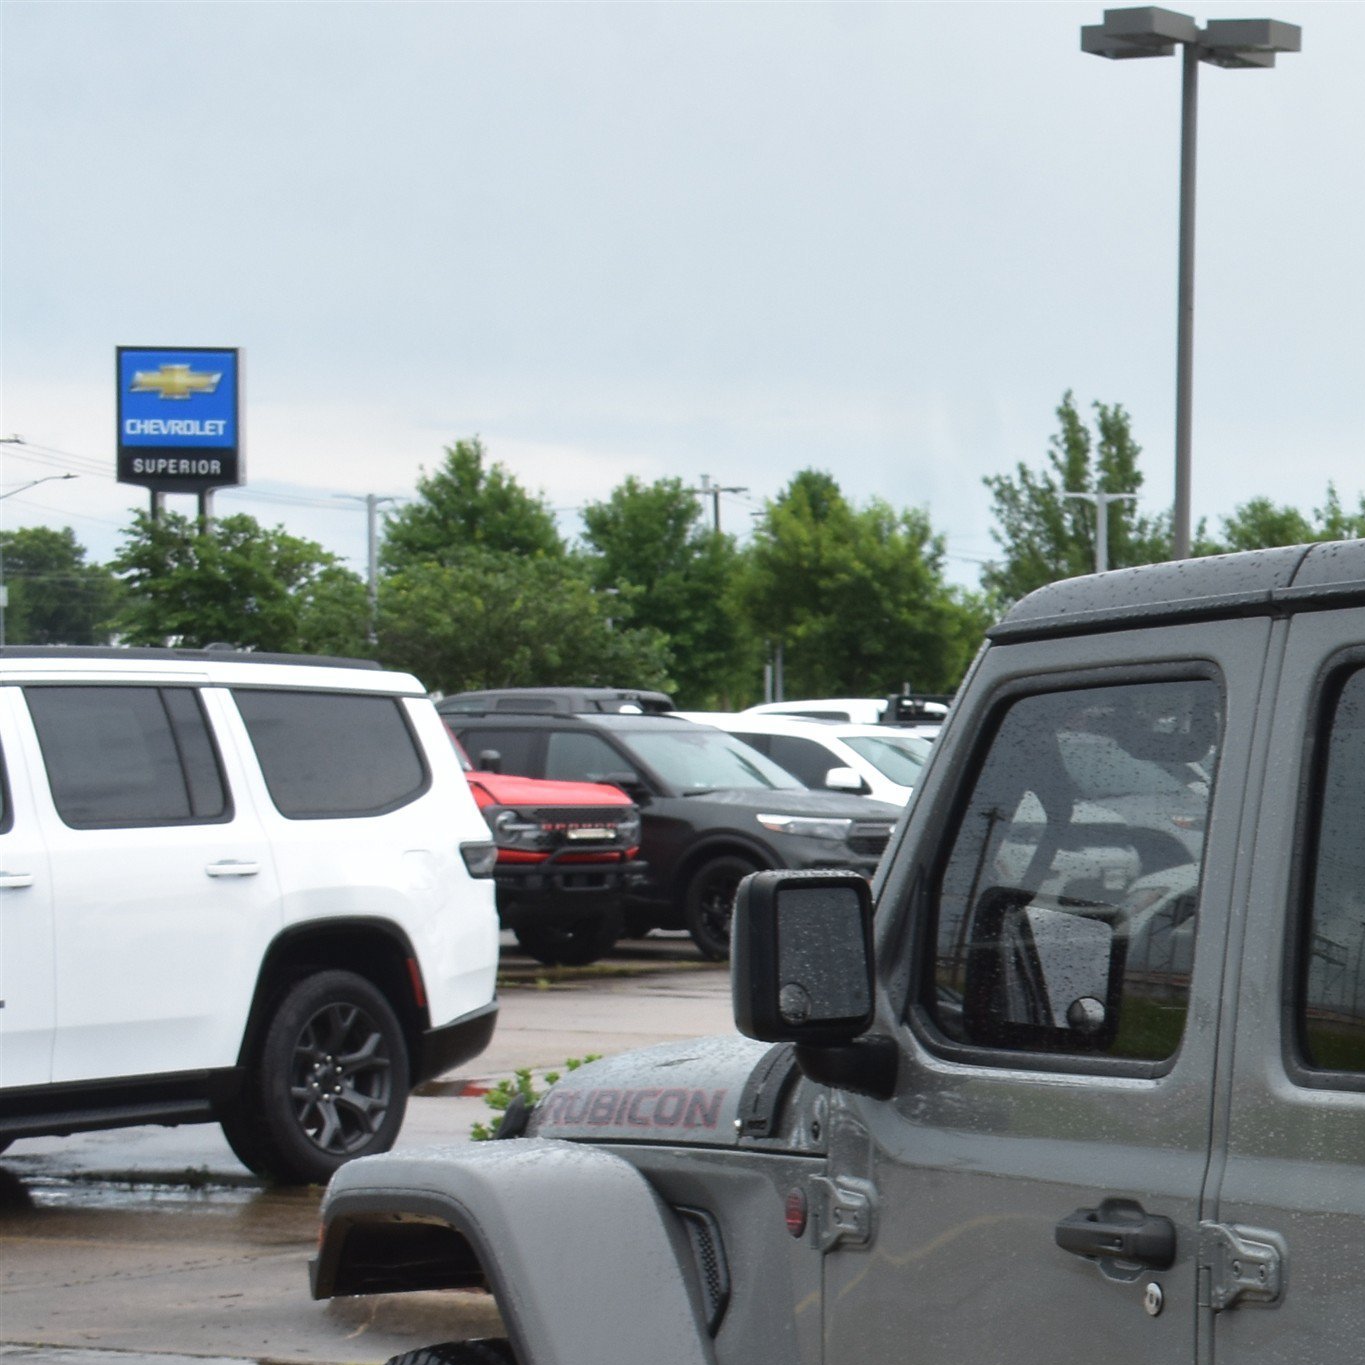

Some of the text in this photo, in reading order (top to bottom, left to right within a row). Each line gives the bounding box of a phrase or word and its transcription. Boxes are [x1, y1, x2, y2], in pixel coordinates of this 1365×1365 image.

[124, 419, 227, 436] CHEVROLET
[132, 458, 222, 475] SUPERIOR
[539, 1087, 728, 1131] RUBICON
